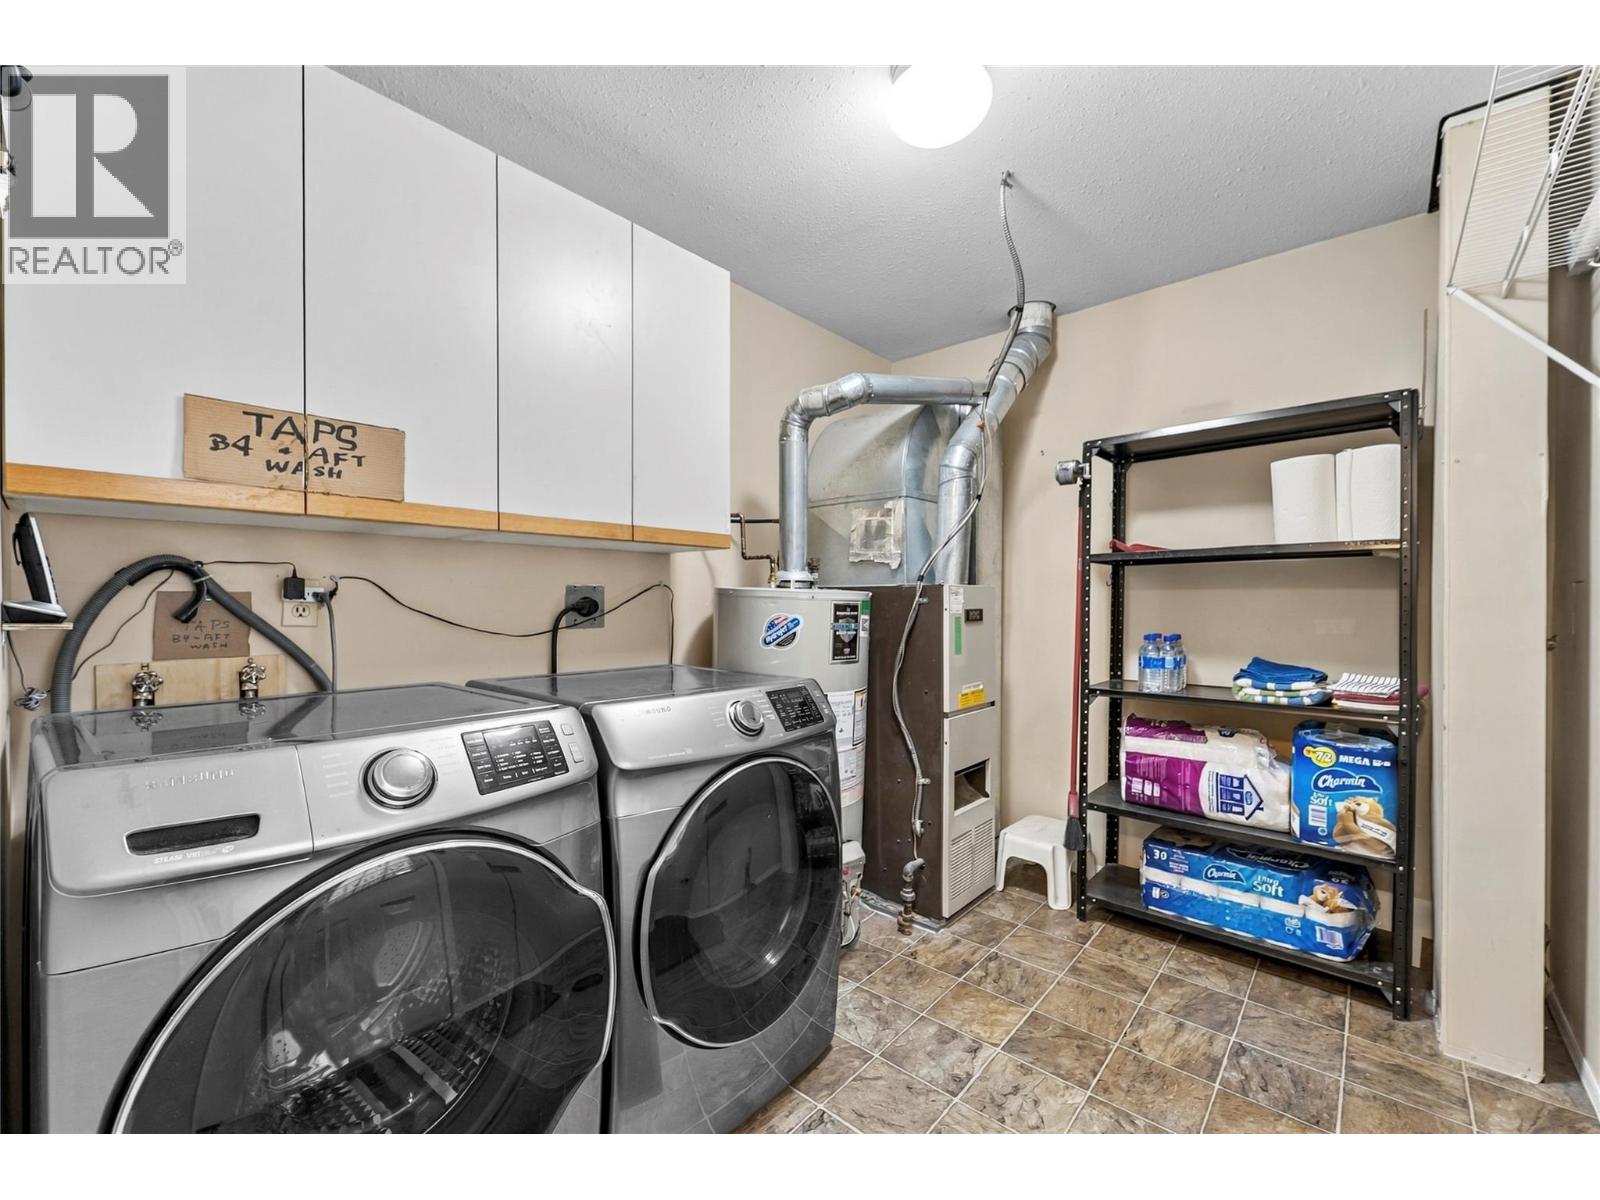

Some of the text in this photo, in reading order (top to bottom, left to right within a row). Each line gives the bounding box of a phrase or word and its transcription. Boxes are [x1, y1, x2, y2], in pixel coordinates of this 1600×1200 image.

[242, 411, 358, 452] TAPS
[209, 433, 253, 456] B4
[308, 447, 366, 468] AFT
[266, 459, 343, 479] WASH
[141, 663, 150, 671] H
[1339, 754, 1371, 766] MEGA
[1317, 775, 1366, 788] Charmin
[1153, 849, 1168, 860] 30
[1207, 867, 1237, 880] Charmin
[1253, 881, 1284, 898] Soft
